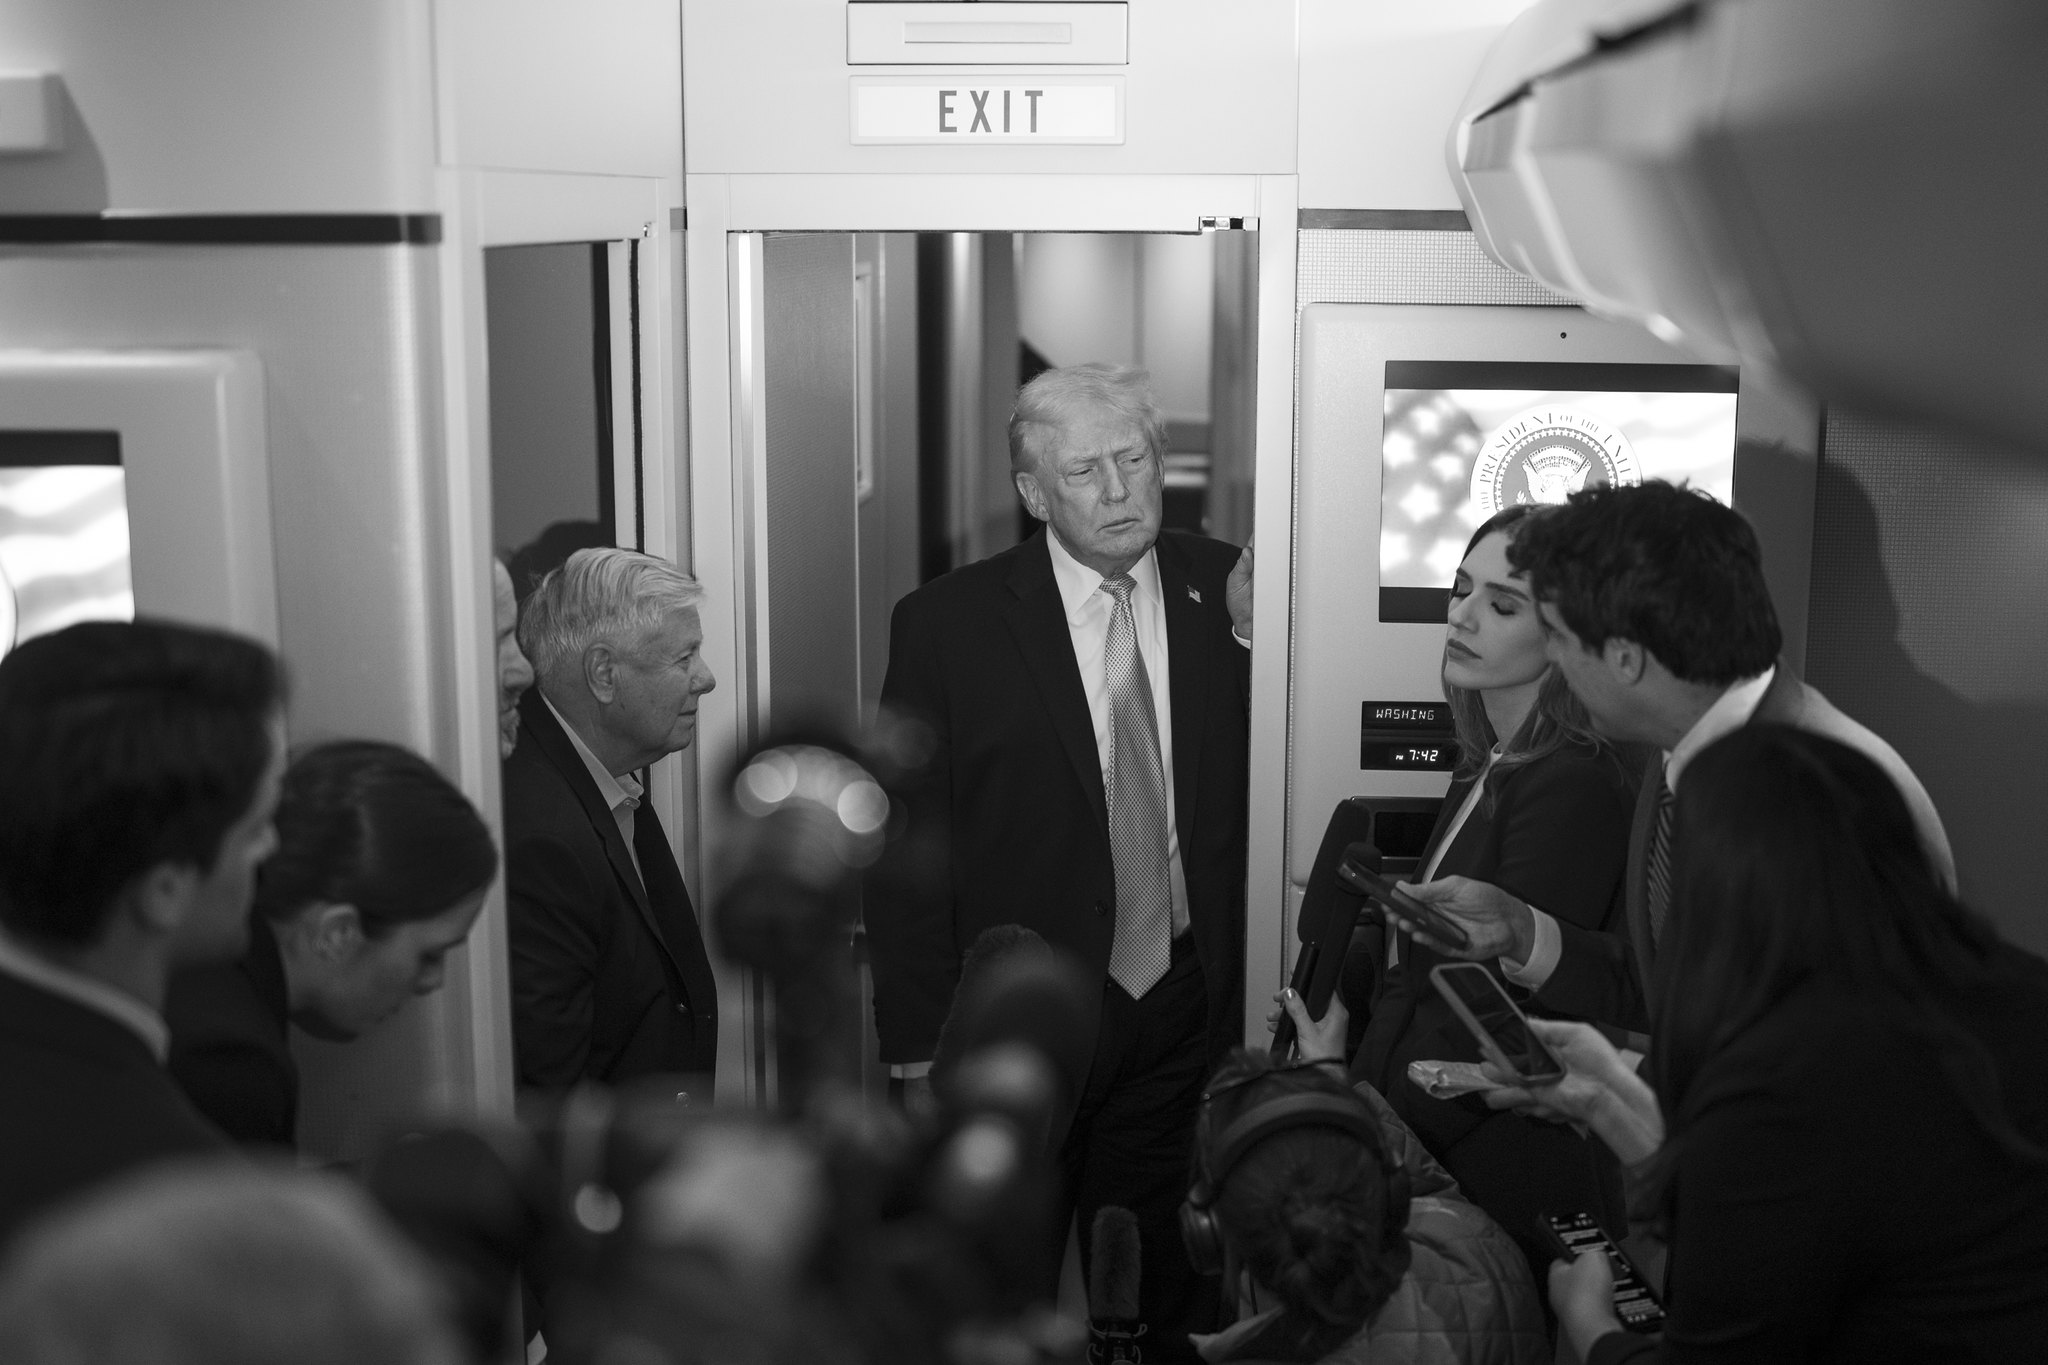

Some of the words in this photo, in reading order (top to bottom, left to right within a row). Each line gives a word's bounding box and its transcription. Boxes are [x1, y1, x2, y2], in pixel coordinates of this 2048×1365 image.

[938, 90, 1043, 133] EXIT
[1479, 412, 1551, 483] PRESIDENT
[1375, 708, 1435, 721] WASHING
[1409, 749, 1439, 762] 7:42
